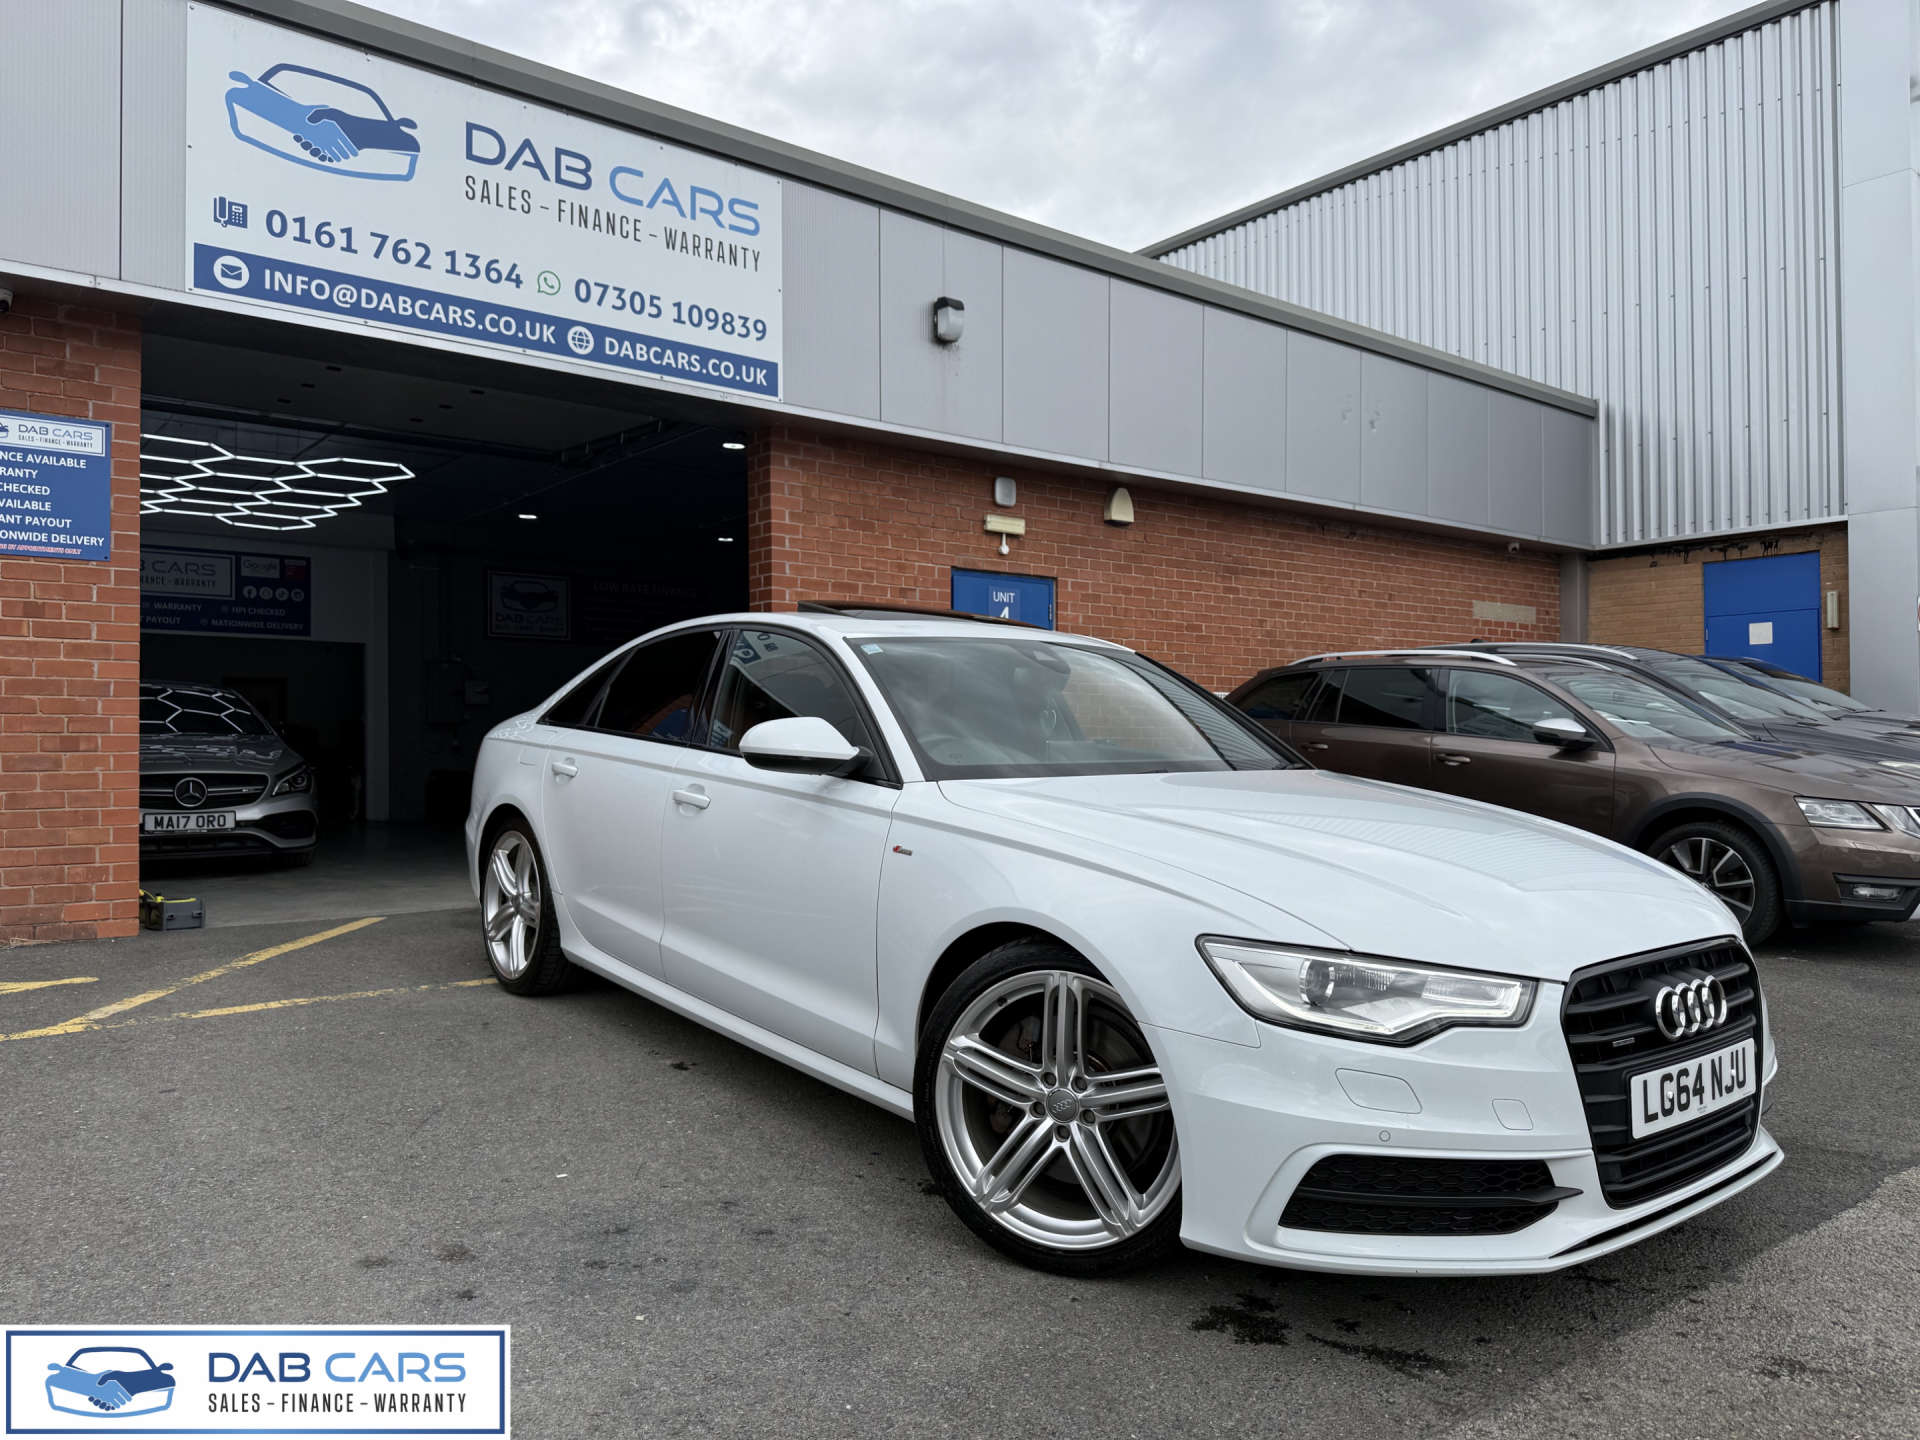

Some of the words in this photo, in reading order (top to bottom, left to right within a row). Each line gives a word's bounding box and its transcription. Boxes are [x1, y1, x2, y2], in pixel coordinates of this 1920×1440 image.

[464, 120, 594, 191] DAB
[608, 164, 761, 237] CARS
[463, 174, 532, 215] SALES
[557, 199, 643, 243] FINANCE
[664, 227, 761, 273] WARRANTY
[264, 209, 358, 254] 0161
[369, 231, 433, 271] 762
[444, 249, 524, 290] 1364
[573, 278, 663, 320] 07305
[671, 300, 768, 342] 109839
[263, 268, 557, 346] INFO@DABCARS.CO.UK
[603, 336, 768, 387] DABCARS.CO.UK
[18, 424, 49, 436] DAB
[52, 428, 93, 441] CARS
[26, 453, 87, 469] AVAILABLE
[25, 516, 72, 529] PAYOUT
[51, 533, 105, 547] DELIVERY
[151, 560, 217, 577] CARS
[993, 591, 1016, 604] UNIT
[154, 815, 191, 829] MA17
[1643, 1063, 1705, 1124] LG64
[1711, 1047, 1747, 1100] NJU
